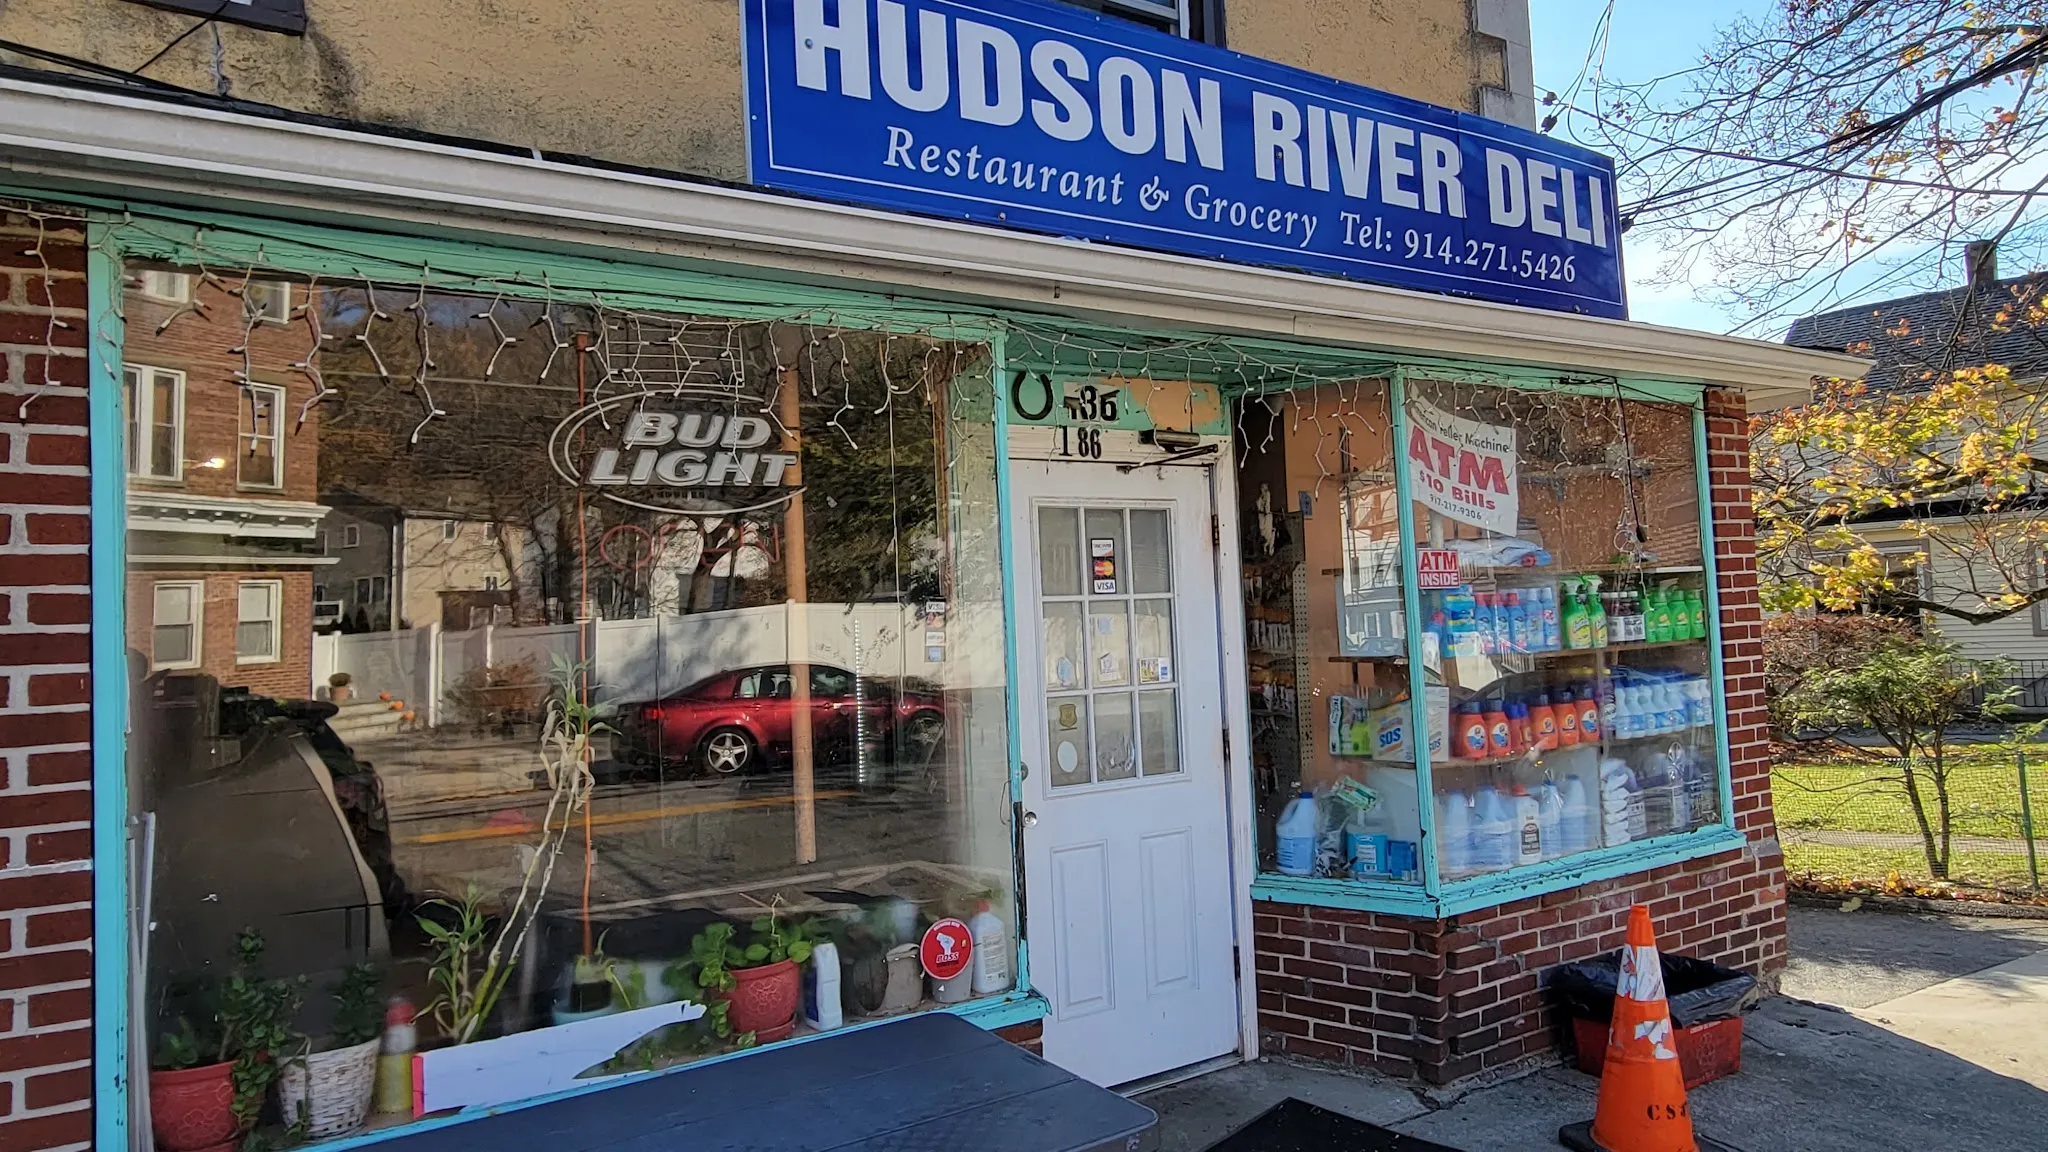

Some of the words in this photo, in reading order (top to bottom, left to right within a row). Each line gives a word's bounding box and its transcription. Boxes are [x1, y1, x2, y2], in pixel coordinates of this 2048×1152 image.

[793, 0, 1223, 171] HUDSON
[1252, 90, 1467, 219] RIVER
[1485, 147, 1607, 249] DELI
[883, 125, 1124, 206] Restaurant
[1139, 175, 1169, 212] &
[1185, 184, 1318, 248] Grocery
[1340, 210, 1392, 252] Tel:
[1404, 228, 1577, 284] 914.271.5426
[622, 411, 772, 449] BUD
[1058, 425, 1102, 460] 186
[1465, 433, 1510, 453] Machine
[585, 449, 798, 487] LIGHT
[1408, 424, 1510, 496] ATM
[1419, 470, 1444, 493] $10
[1451, 485, 1496, 510] Bills
[1419, 551, 1458, 571] ATM
[1096, 582, 1115, 591] VISA
[1419, 572, 1460, 588] INSIDE
[1379, 727, 1402, 748] SOS
